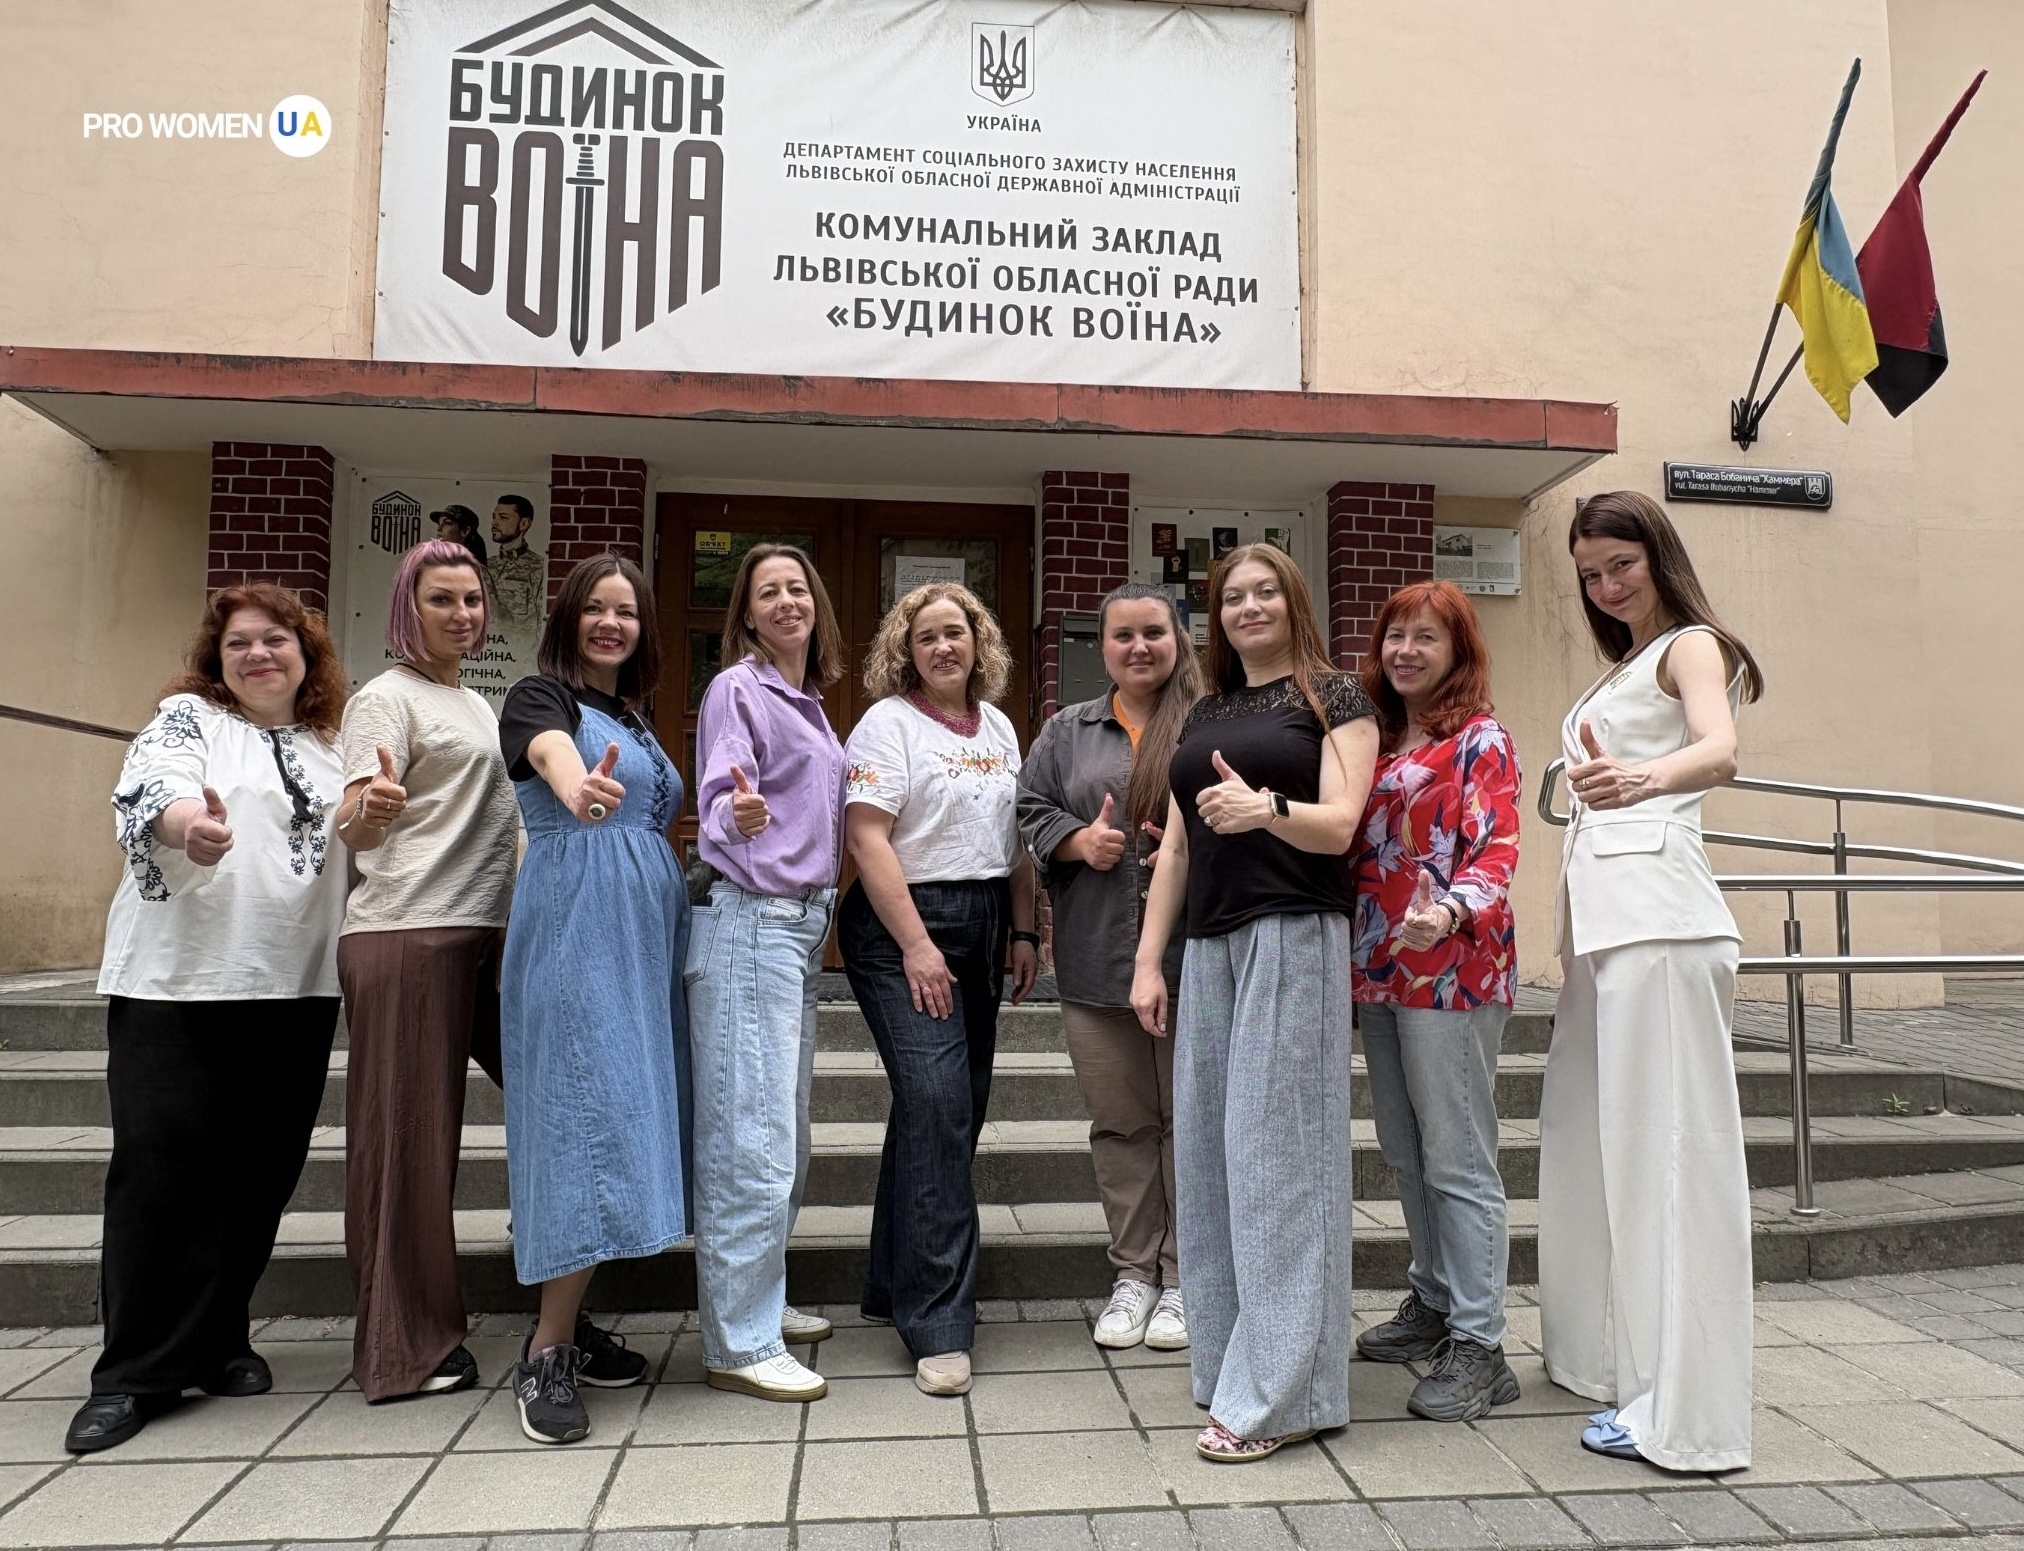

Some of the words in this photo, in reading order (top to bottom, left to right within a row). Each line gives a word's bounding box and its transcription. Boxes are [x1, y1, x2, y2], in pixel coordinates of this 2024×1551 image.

[449, 58, 725, 135] БУДИНОК
[966, 114, 1042, 133] УКРАЇНА
[783, 142, 916, 163] ДЕПАРТАМЕНТ
[922, 149, 1046, 170] СОЦІАЛЬНОГО
[1052, 157, 1129, 174] ЗАХИСТУ
[1135, 162, 1237, 181] НАСЕЛЕННЯ
[785, 164, 896, 183] ЛЬВІВСЬКОЇ
[901, 170, 992, 189] ОБЛАСНОЇ
[997, 175, 1104, 195] ДЕРЖАВНОЇ
[1109, 181, 1241, 204] АДМІНІСТРАЦІЇ
[816, 212, 1077, 250] КОМУНАЛЬНИЙ
[1091, 226, 1222, 263] ЗАКЛАД
[773, 254, 981, 290] ЛЬВІВСЬКОЇ
[993, 264, 1161, 298] ОБЛАСНОЇ
[1174, 274, 1258, 307] РАДИ
[826, 297, 1054, 338] «БУДИНОК
[1073, 301, 1222, 344] ВОЇНА»
[1690, 470, 1720, 481] Тараса
[372, 503, 421, 516] БУДИНОК
